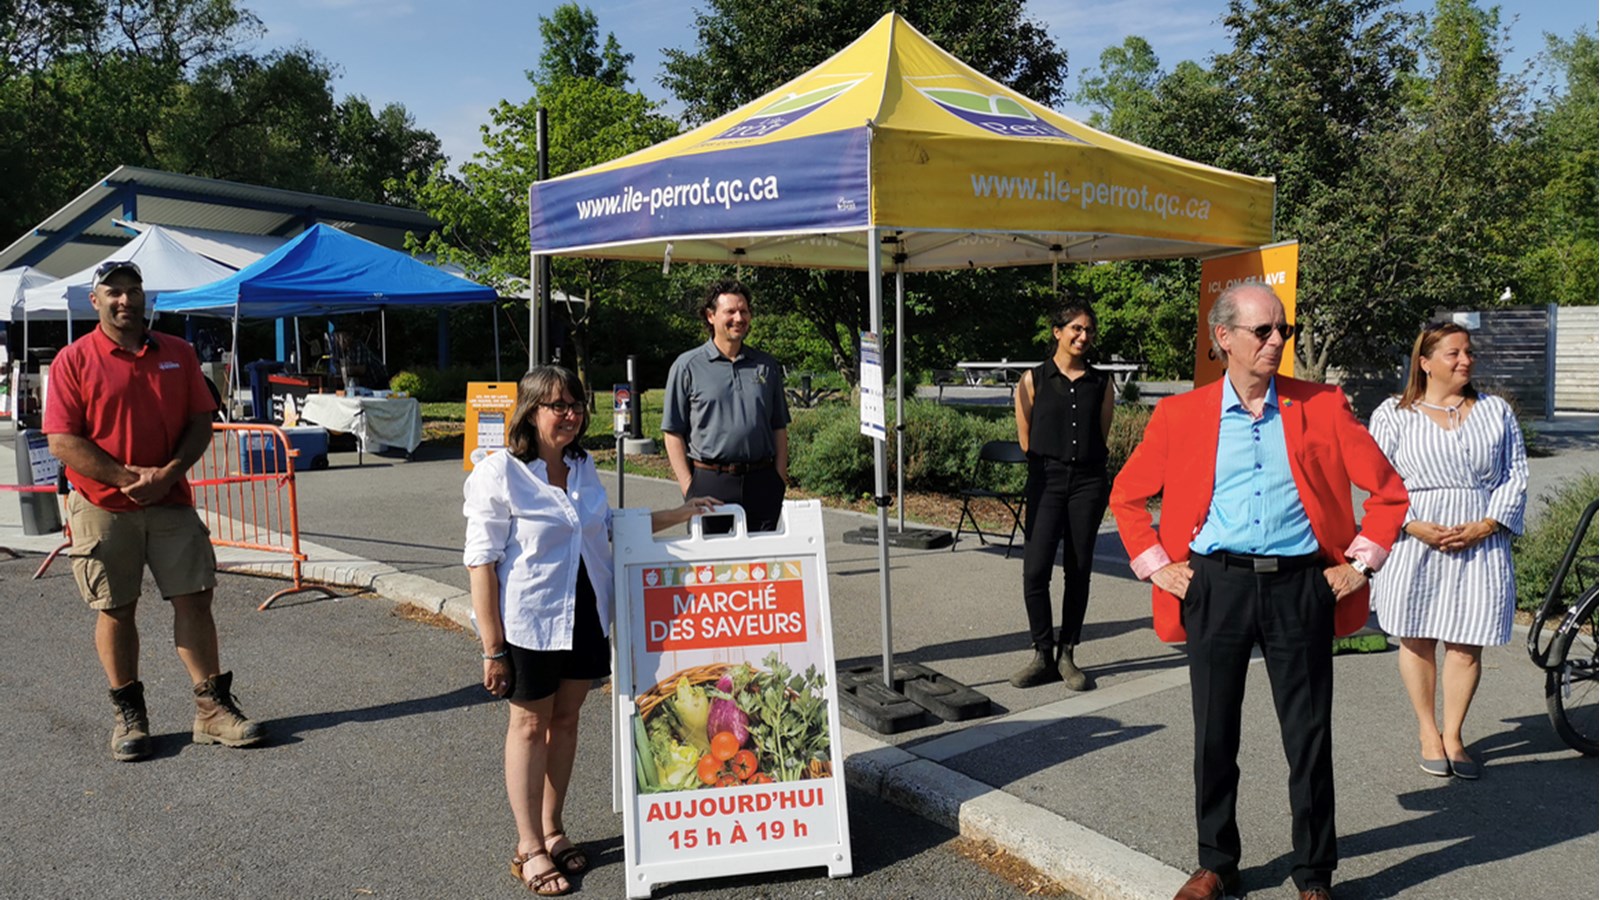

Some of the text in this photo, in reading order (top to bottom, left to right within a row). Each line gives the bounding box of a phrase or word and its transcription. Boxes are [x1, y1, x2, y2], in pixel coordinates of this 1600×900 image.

[577, 176, 778, 219] www.ile-perrot.qc.ca
[971, 171, 1211, 220] www.ile-perrot.qc.ca
[673, 583, 777, 615] MARCHÉ
[650, 612, 802, 642] DES SAVEURS
[646, 787, 824, 822] AUJOURD'HUI
[668, 819, 808, 850] 15 h À 19 h
